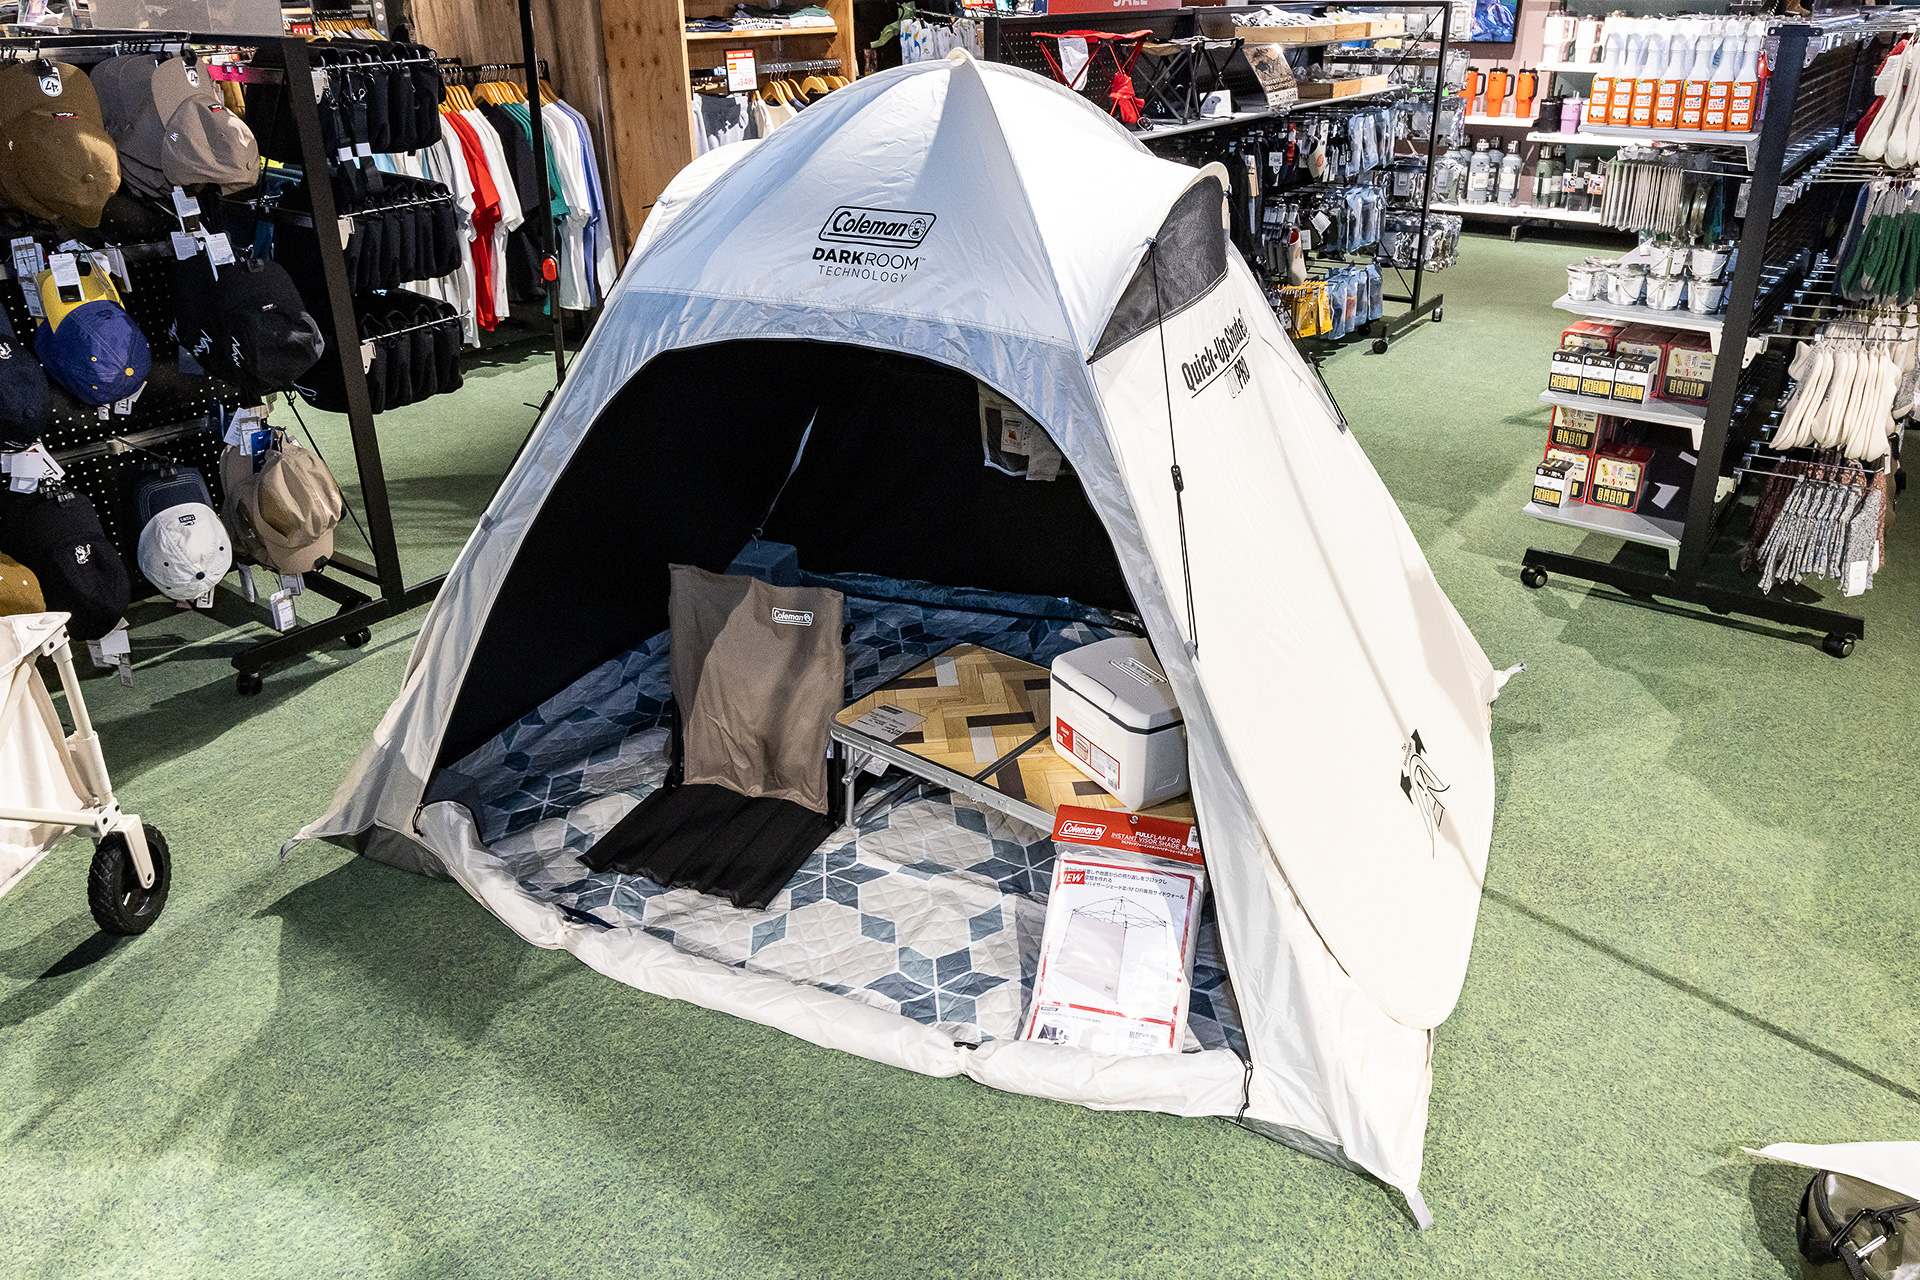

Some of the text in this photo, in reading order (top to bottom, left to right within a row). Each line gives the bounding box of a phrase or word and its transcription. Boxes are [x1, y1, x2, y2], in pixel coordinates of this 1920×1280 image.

[832, 210, 909, 237] Coleman
[818, 264, 908, 284] TECHNOLOGY
[773, 609, 804, 622] Coleman
[1064, 822, 1095, 835] Coleman
[1111, 832, 1137, 842] INSTANT
[1138, 836, 1157, 845] VISOR
[1158, 840, 1179, 849] SHADE
[1167, 836, 1181, 844] FOR
